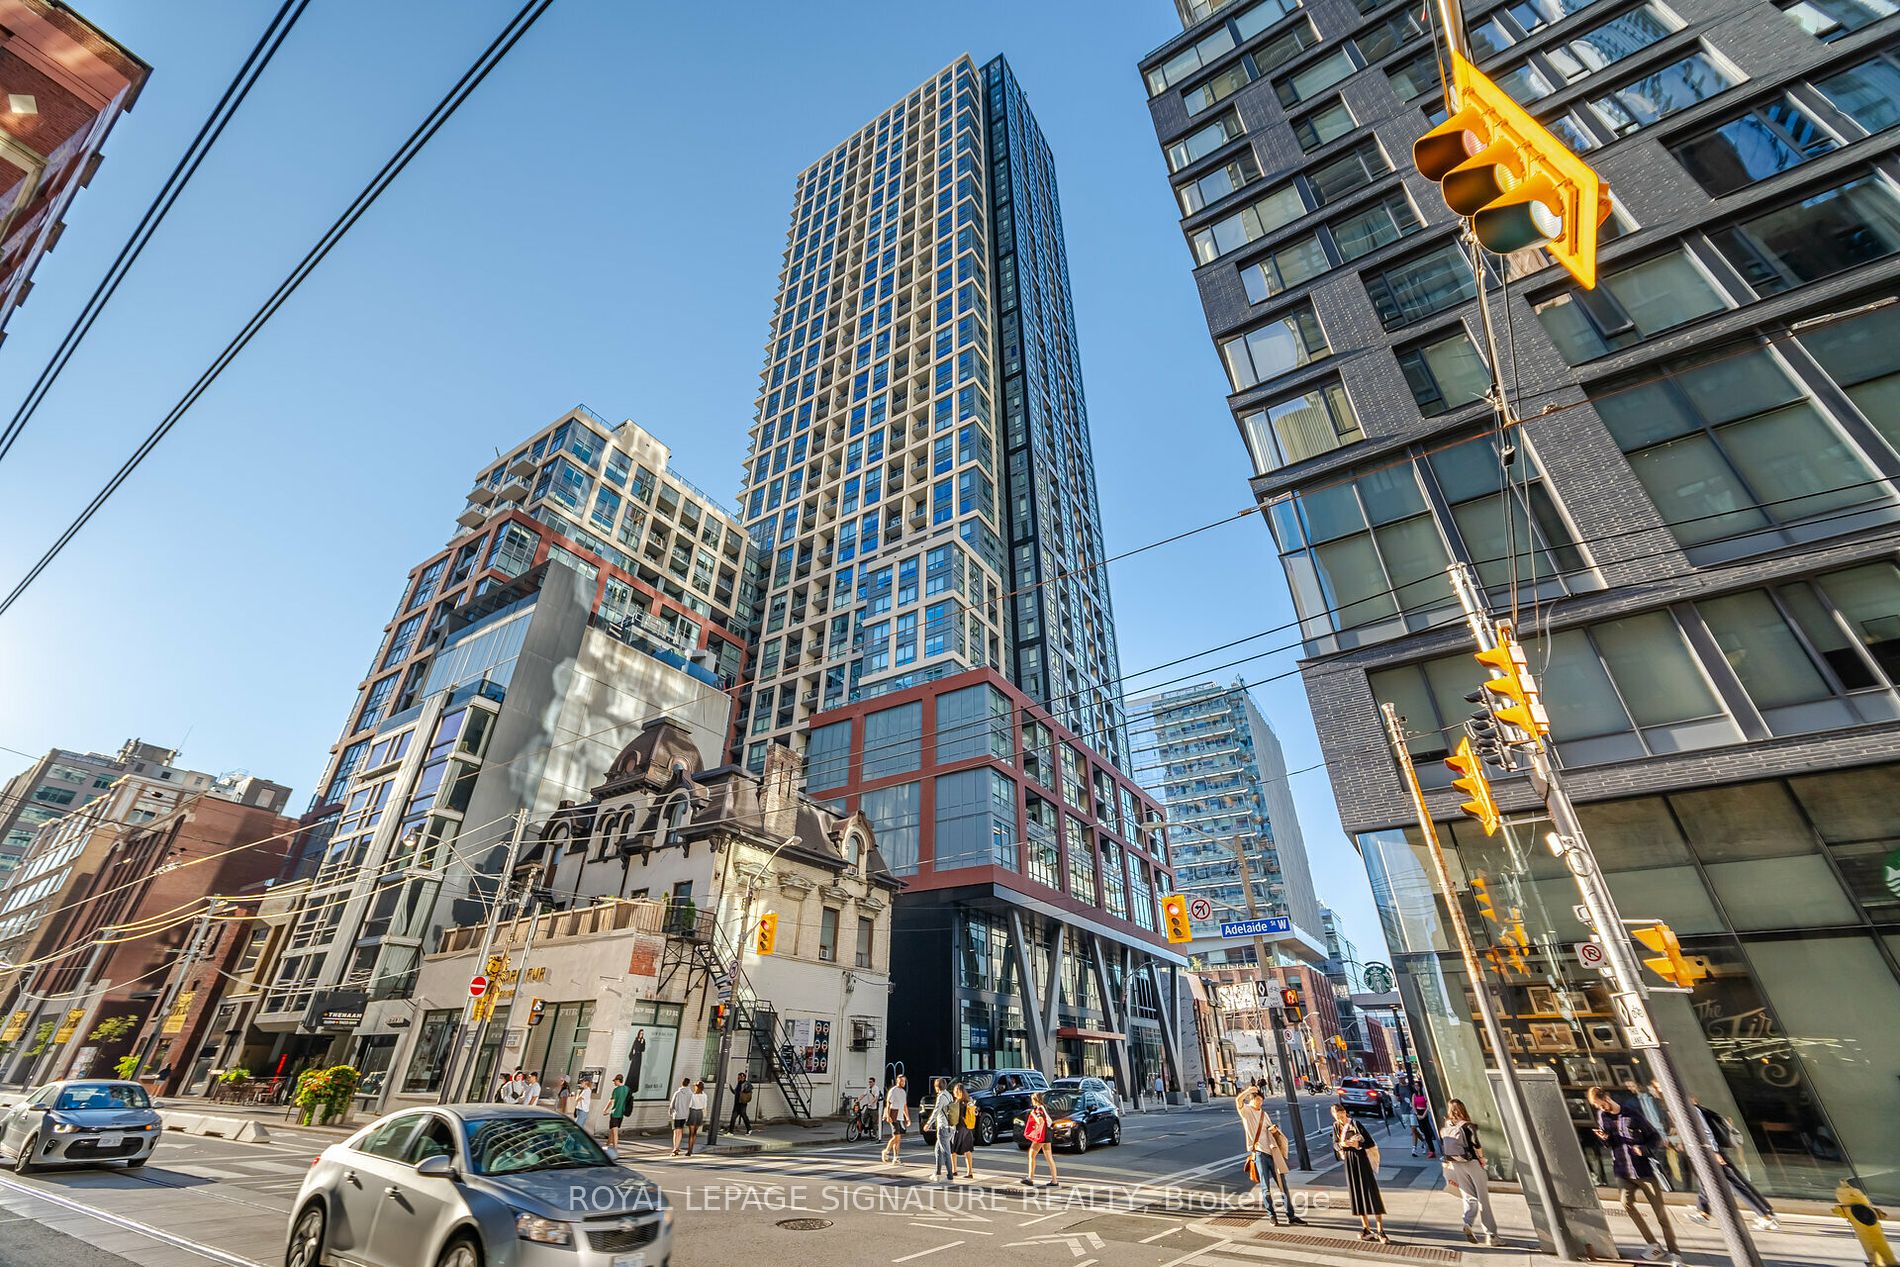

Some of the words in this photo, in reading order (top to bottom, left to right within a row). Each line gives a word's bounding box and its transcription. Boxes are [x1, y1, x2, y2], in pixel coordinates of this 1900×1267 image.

[1224, 922, 1268, 935] Adelaide
[1277, 919, 1287, 930] W
[525, 966, 547, 984] FUR
[1693, 999, 1723, 1019] The
